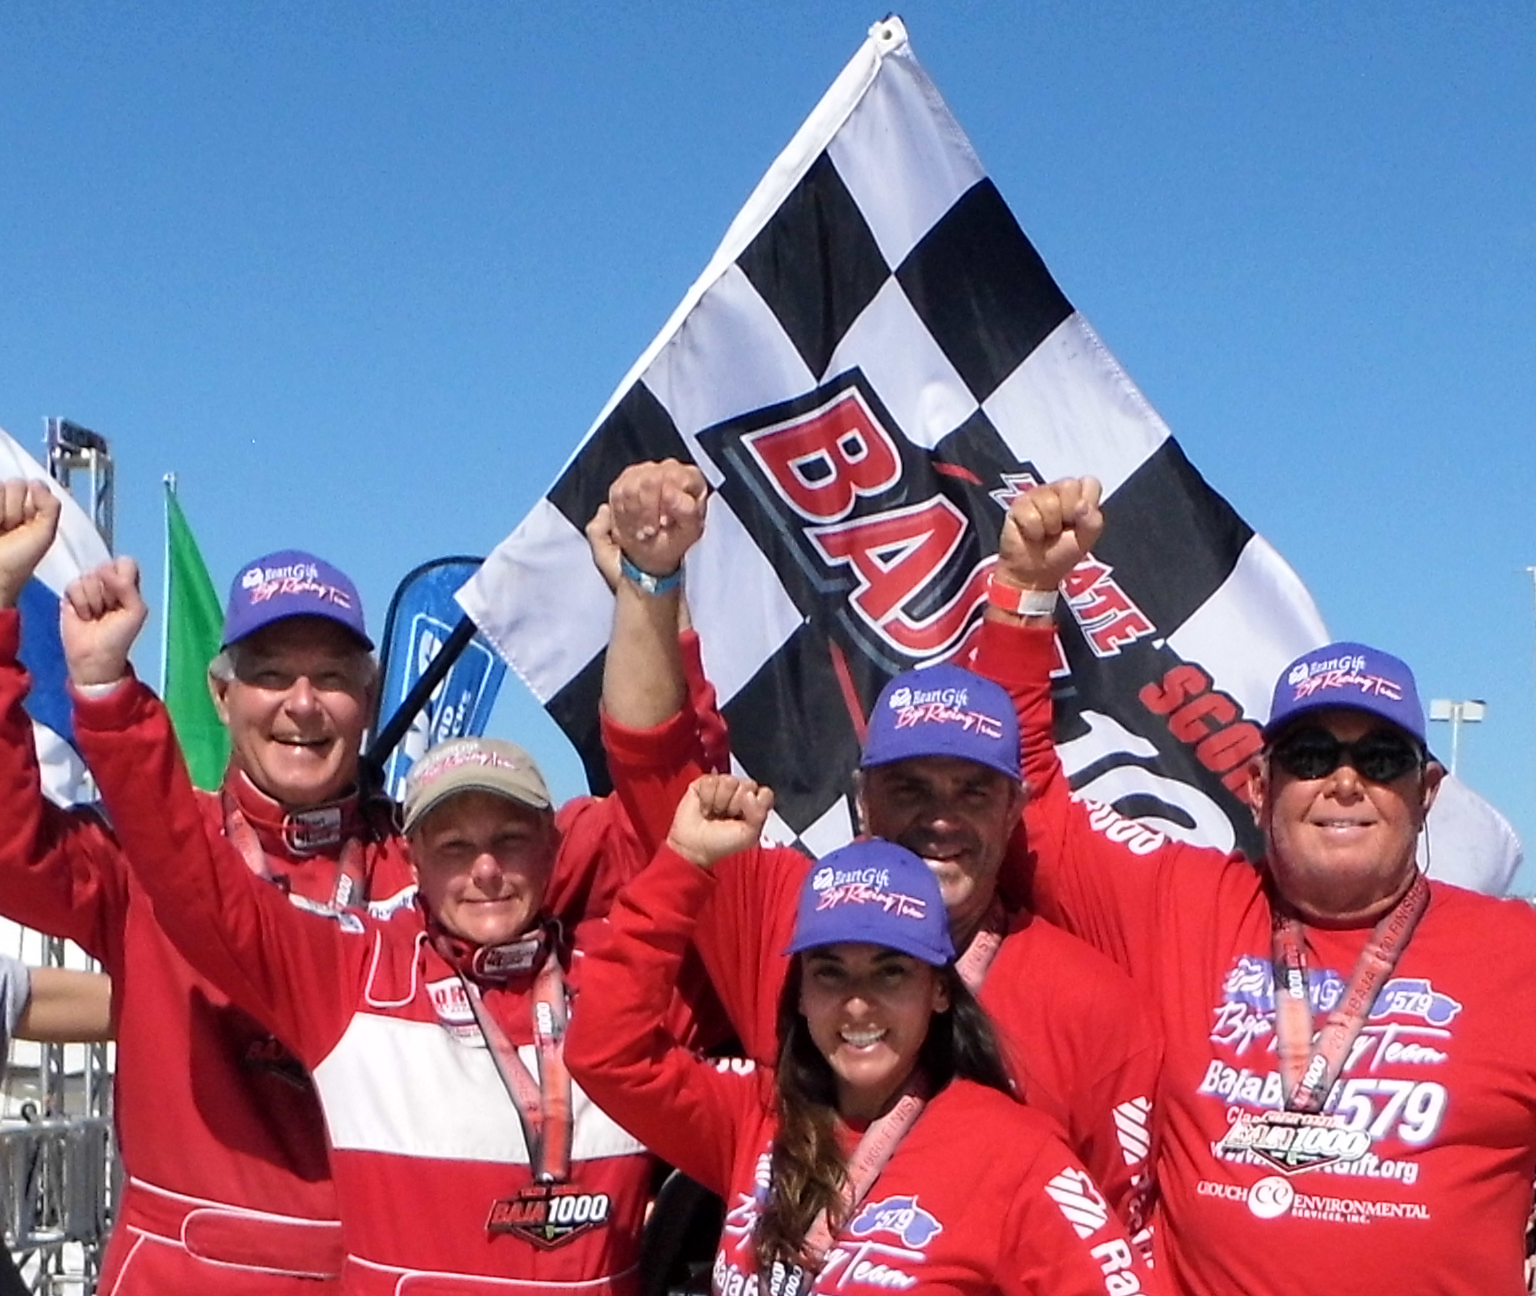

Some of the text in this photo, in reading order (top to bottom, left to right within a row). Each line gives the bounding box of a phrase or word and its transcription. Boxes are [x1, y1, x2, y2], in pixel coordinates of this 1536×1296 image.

[740, 384, 1071, 678] BAJ
[1139, 664, 1266, 803] SCO
[1055, 710, 1236, 853] 10
[1292, 1125, 1370, 1160] 1000
[548, 1194, 610, 1224] 1000
[1293, 1193, 1431, 1219] ENVIRONMENTAL
[837, 1239, 928, 1290] Team
